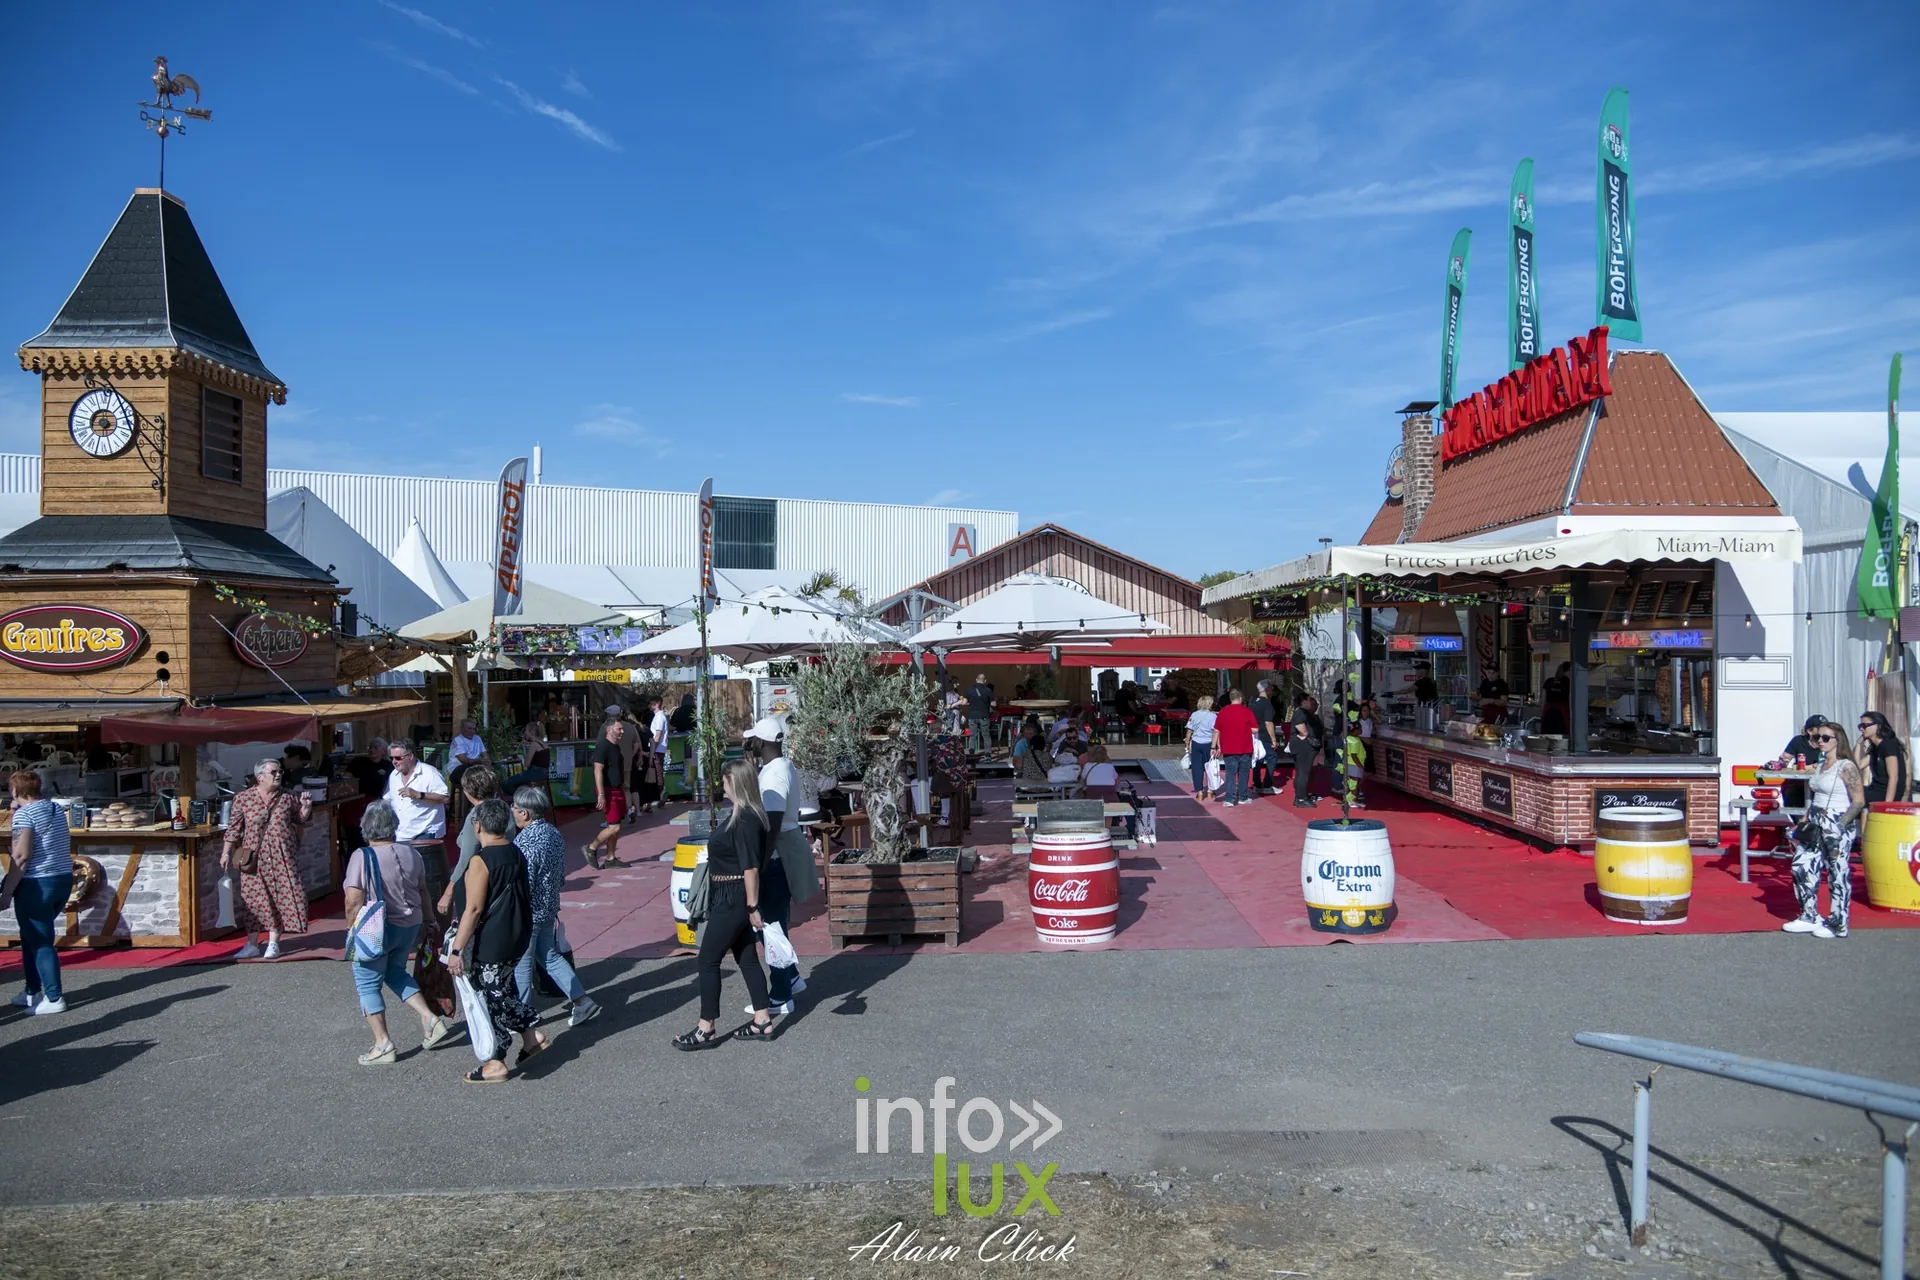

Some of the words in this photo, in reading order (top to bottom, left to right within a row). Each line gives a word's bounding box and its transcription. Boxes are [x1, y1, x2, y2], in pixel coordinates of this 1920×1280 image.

[1609, 174, 1626, 311] BOFFERDING
[1517, 237, 1534, 356] BOFFERDING
[497, 478, 524, 598] APEROL
[950, 526, 974, 557] A
[1656, 537, 1775, 553] Miam-Miam
[2, 619, 126, 653] Gaufres
[1602, 794, 1628, 807] Pan
[1318, 859, 1382, 882] Corona
[1034, 878, 1091, 902] Coca-Cola
[1336, 878, 1373, 893] Extra
[1048, 916, 1079, 929] Coke
